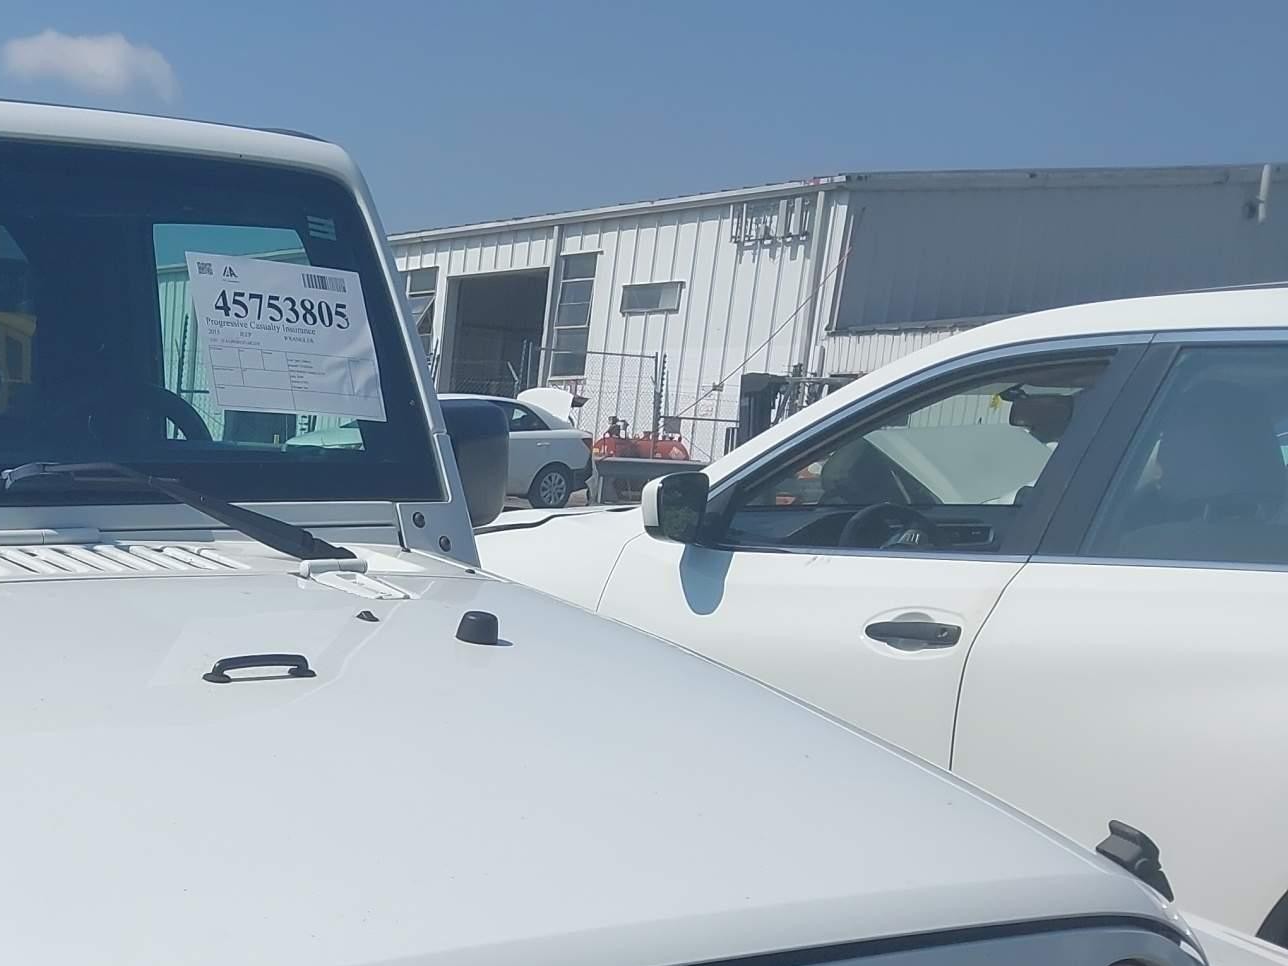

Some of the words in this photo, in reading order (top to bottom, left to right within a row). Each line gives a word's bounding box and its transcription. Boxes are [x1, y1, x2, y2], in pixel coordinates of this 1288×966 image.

[214, 289, 351, 330] 45753805
[206, 317, 249, 329] Progressive
[249, 321, 281, 333] Casualty
